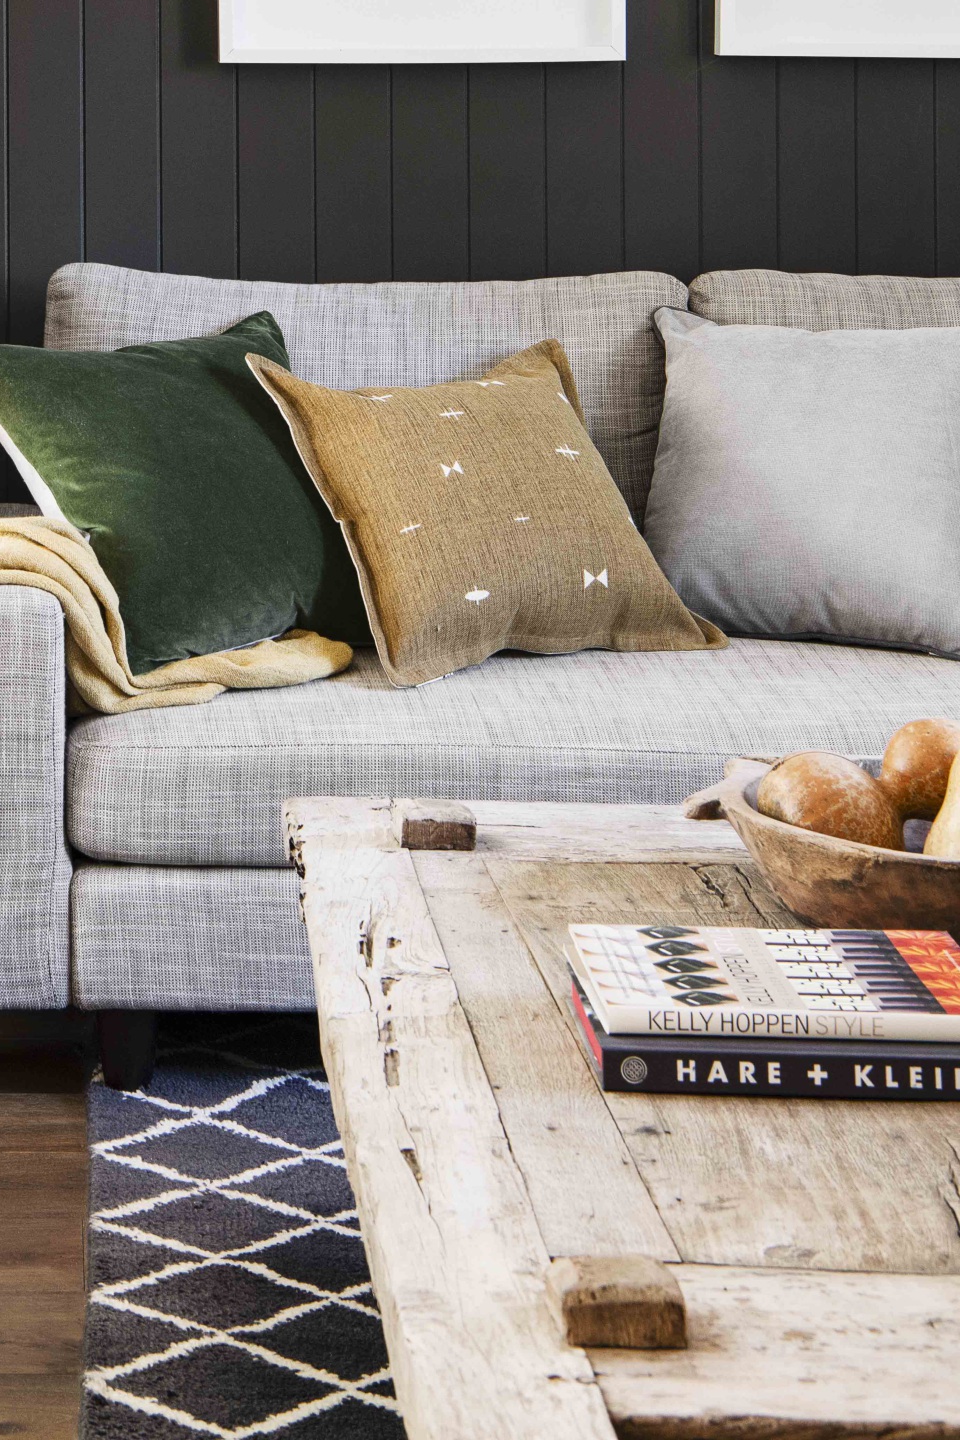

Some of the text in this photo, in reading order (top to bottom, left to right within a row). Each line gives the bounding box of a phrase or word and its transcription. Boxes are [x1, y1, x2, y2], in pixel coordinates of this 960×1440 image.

[648, 1010, 885, 1037] KELLY HOPPEN STYLE
[676, 1059, 782, 1085] HARE
